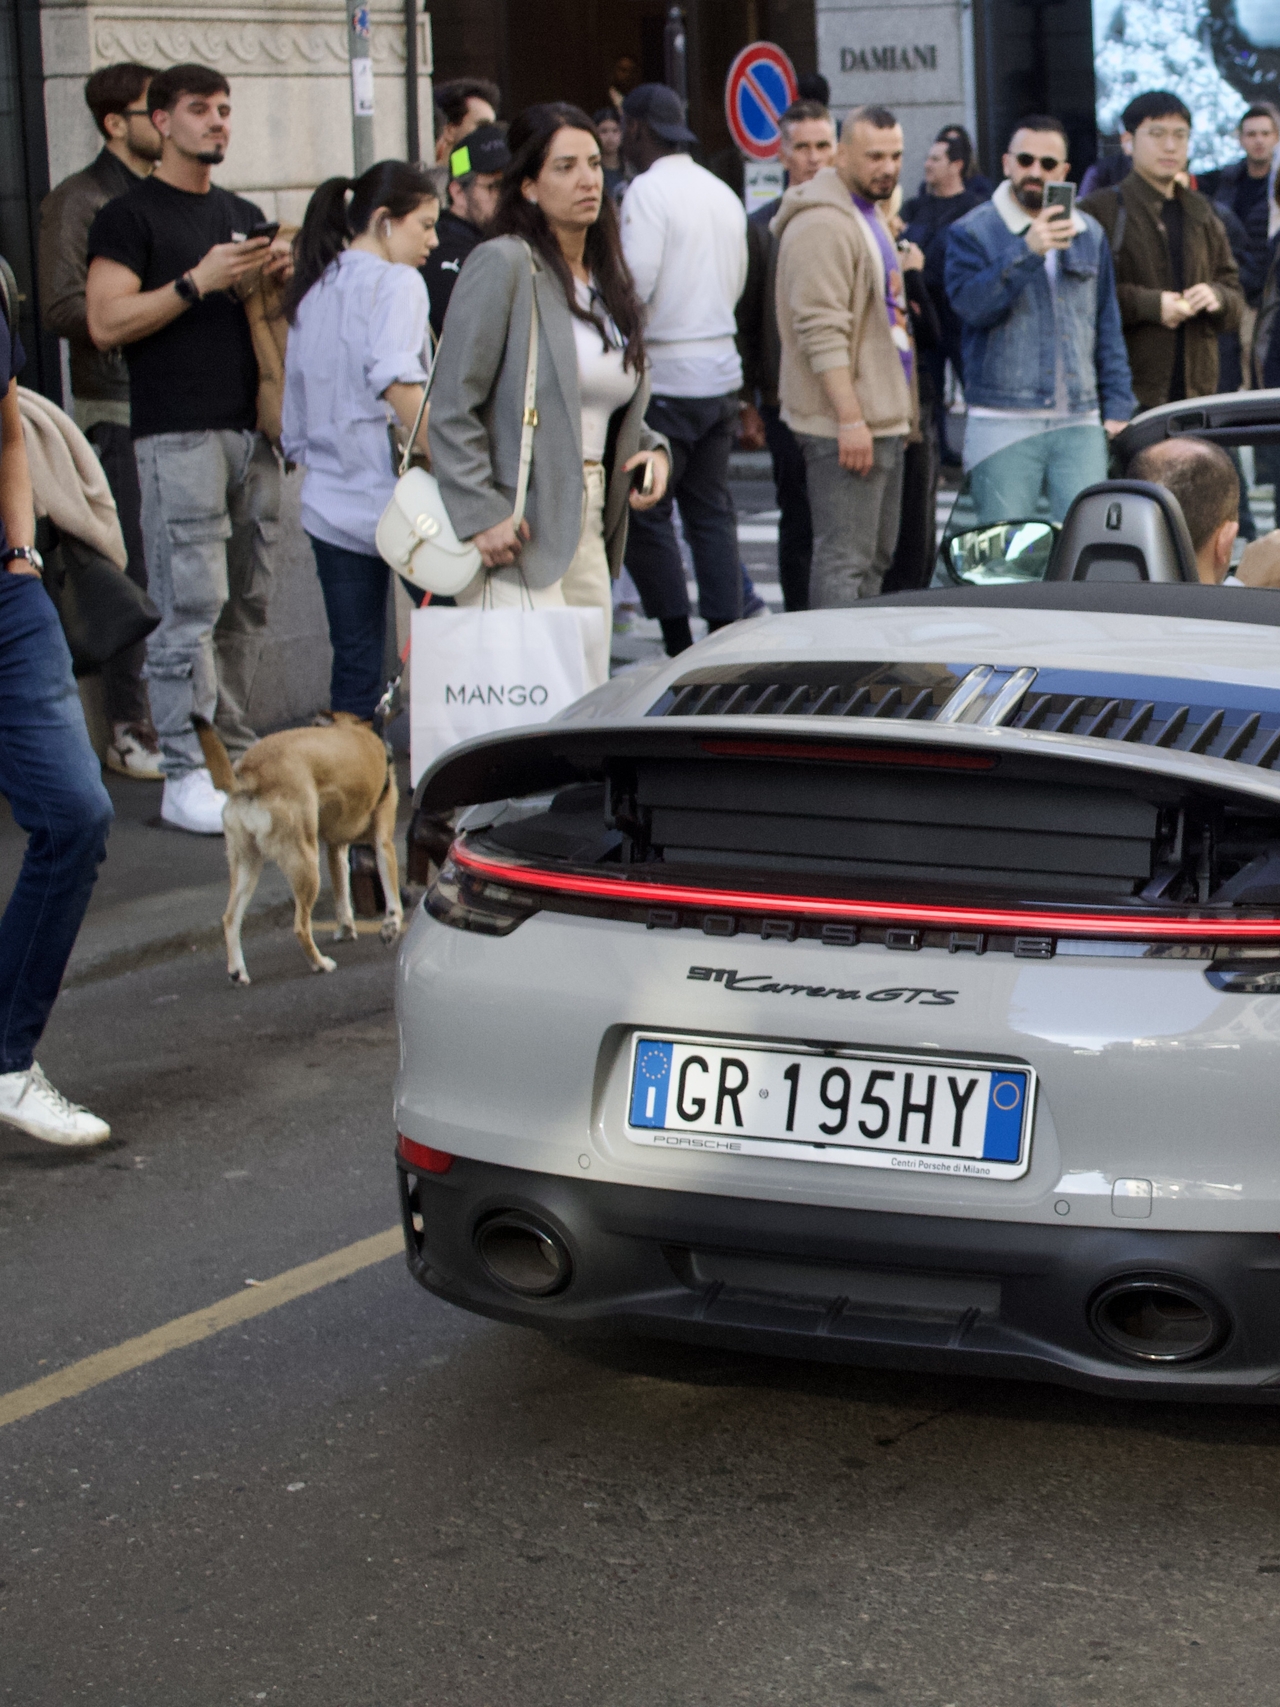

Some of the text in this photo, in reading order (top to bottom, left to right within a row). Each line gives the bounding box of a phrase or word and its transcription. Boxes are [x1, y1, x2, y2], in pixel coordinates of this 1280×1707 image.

[840, 44, 937, 72] DAMIANI
[445, 684, 548, 706] MANGO
[646, 909, 1053, 959] PORSCHE
[686, 965, 960, 1006] 911 Carrera GTS
[676, 1054, 750, 1128] GR
[783, 1062, 980, 1148] 195HY
[653, 1135, 742, 1151] PORSCHE
[890, 1157, 991, 1175] Centri Porsche di Milano
